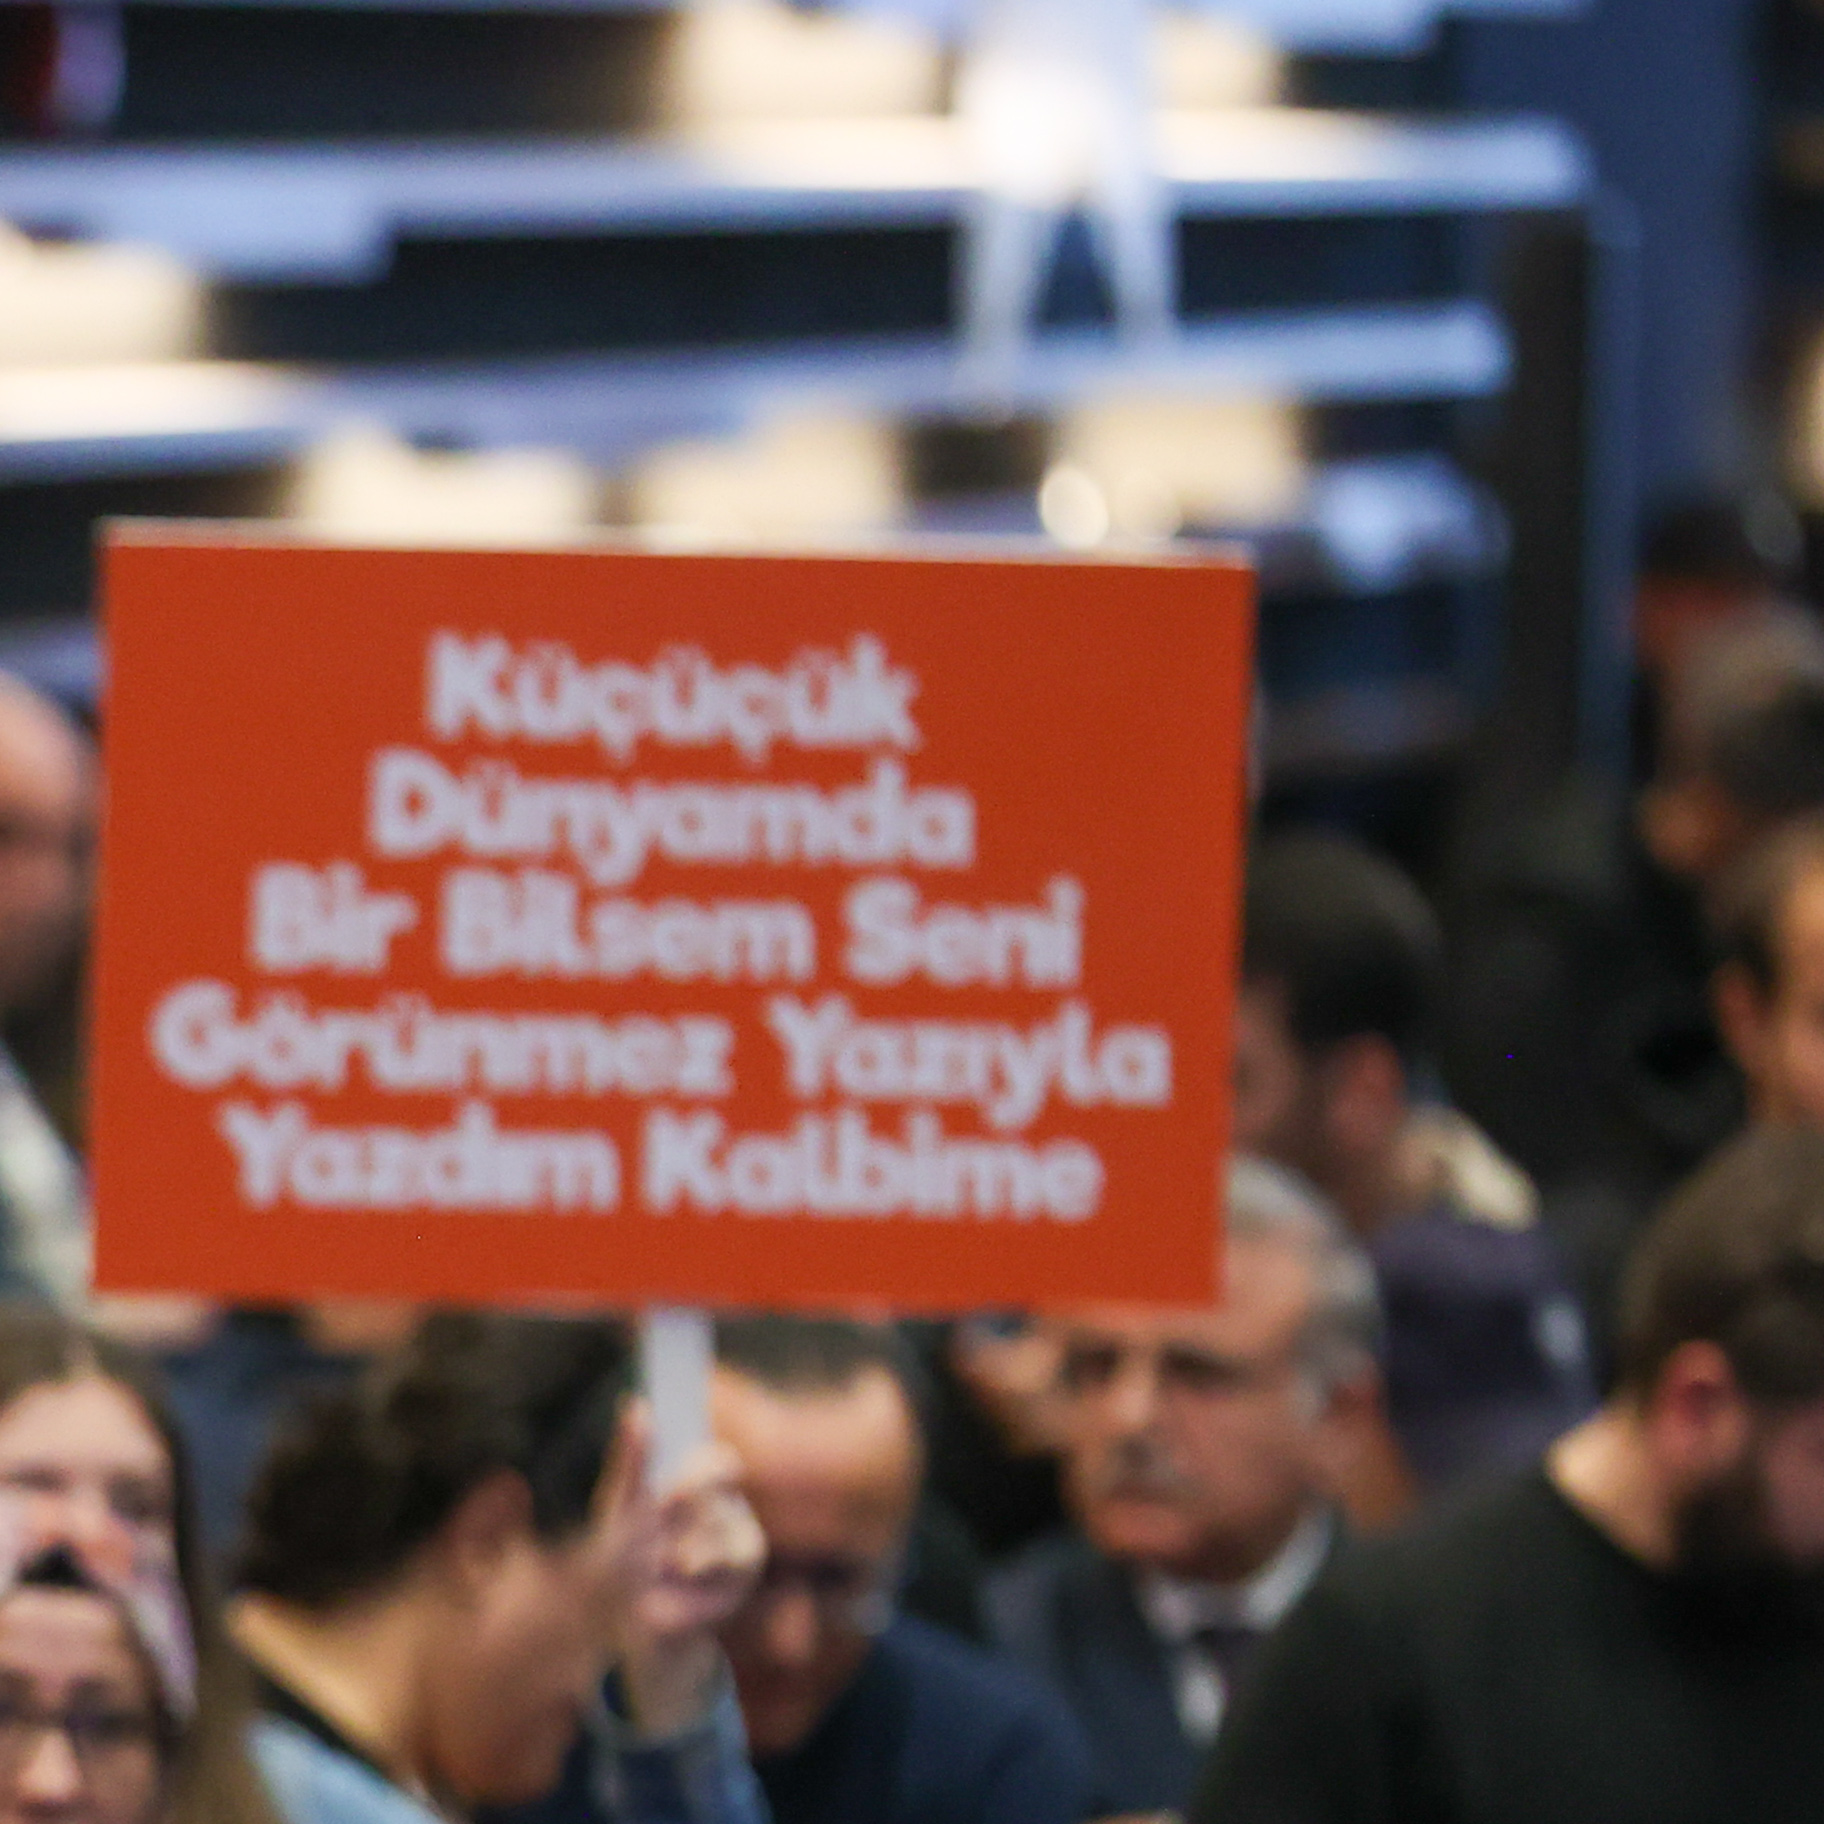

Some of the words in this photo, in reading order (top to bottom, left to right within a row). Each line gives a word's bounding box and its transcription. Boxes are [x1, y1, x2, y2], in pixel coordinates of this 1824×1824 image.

[368, 749, 975, 889] Dünyamda
[250, 863, 417, 973] Bir
[440, 867, 815, 980] Bilsem
[844, 876, 1083, 986] Seni
[150, 981, 734, 1096] Görünmez
[767, 998, 1171, 1132] Yazıyla
[220, 1100, 621, 1210] Yazdım
[639, 1105, 1103, 1220] Kalbime
